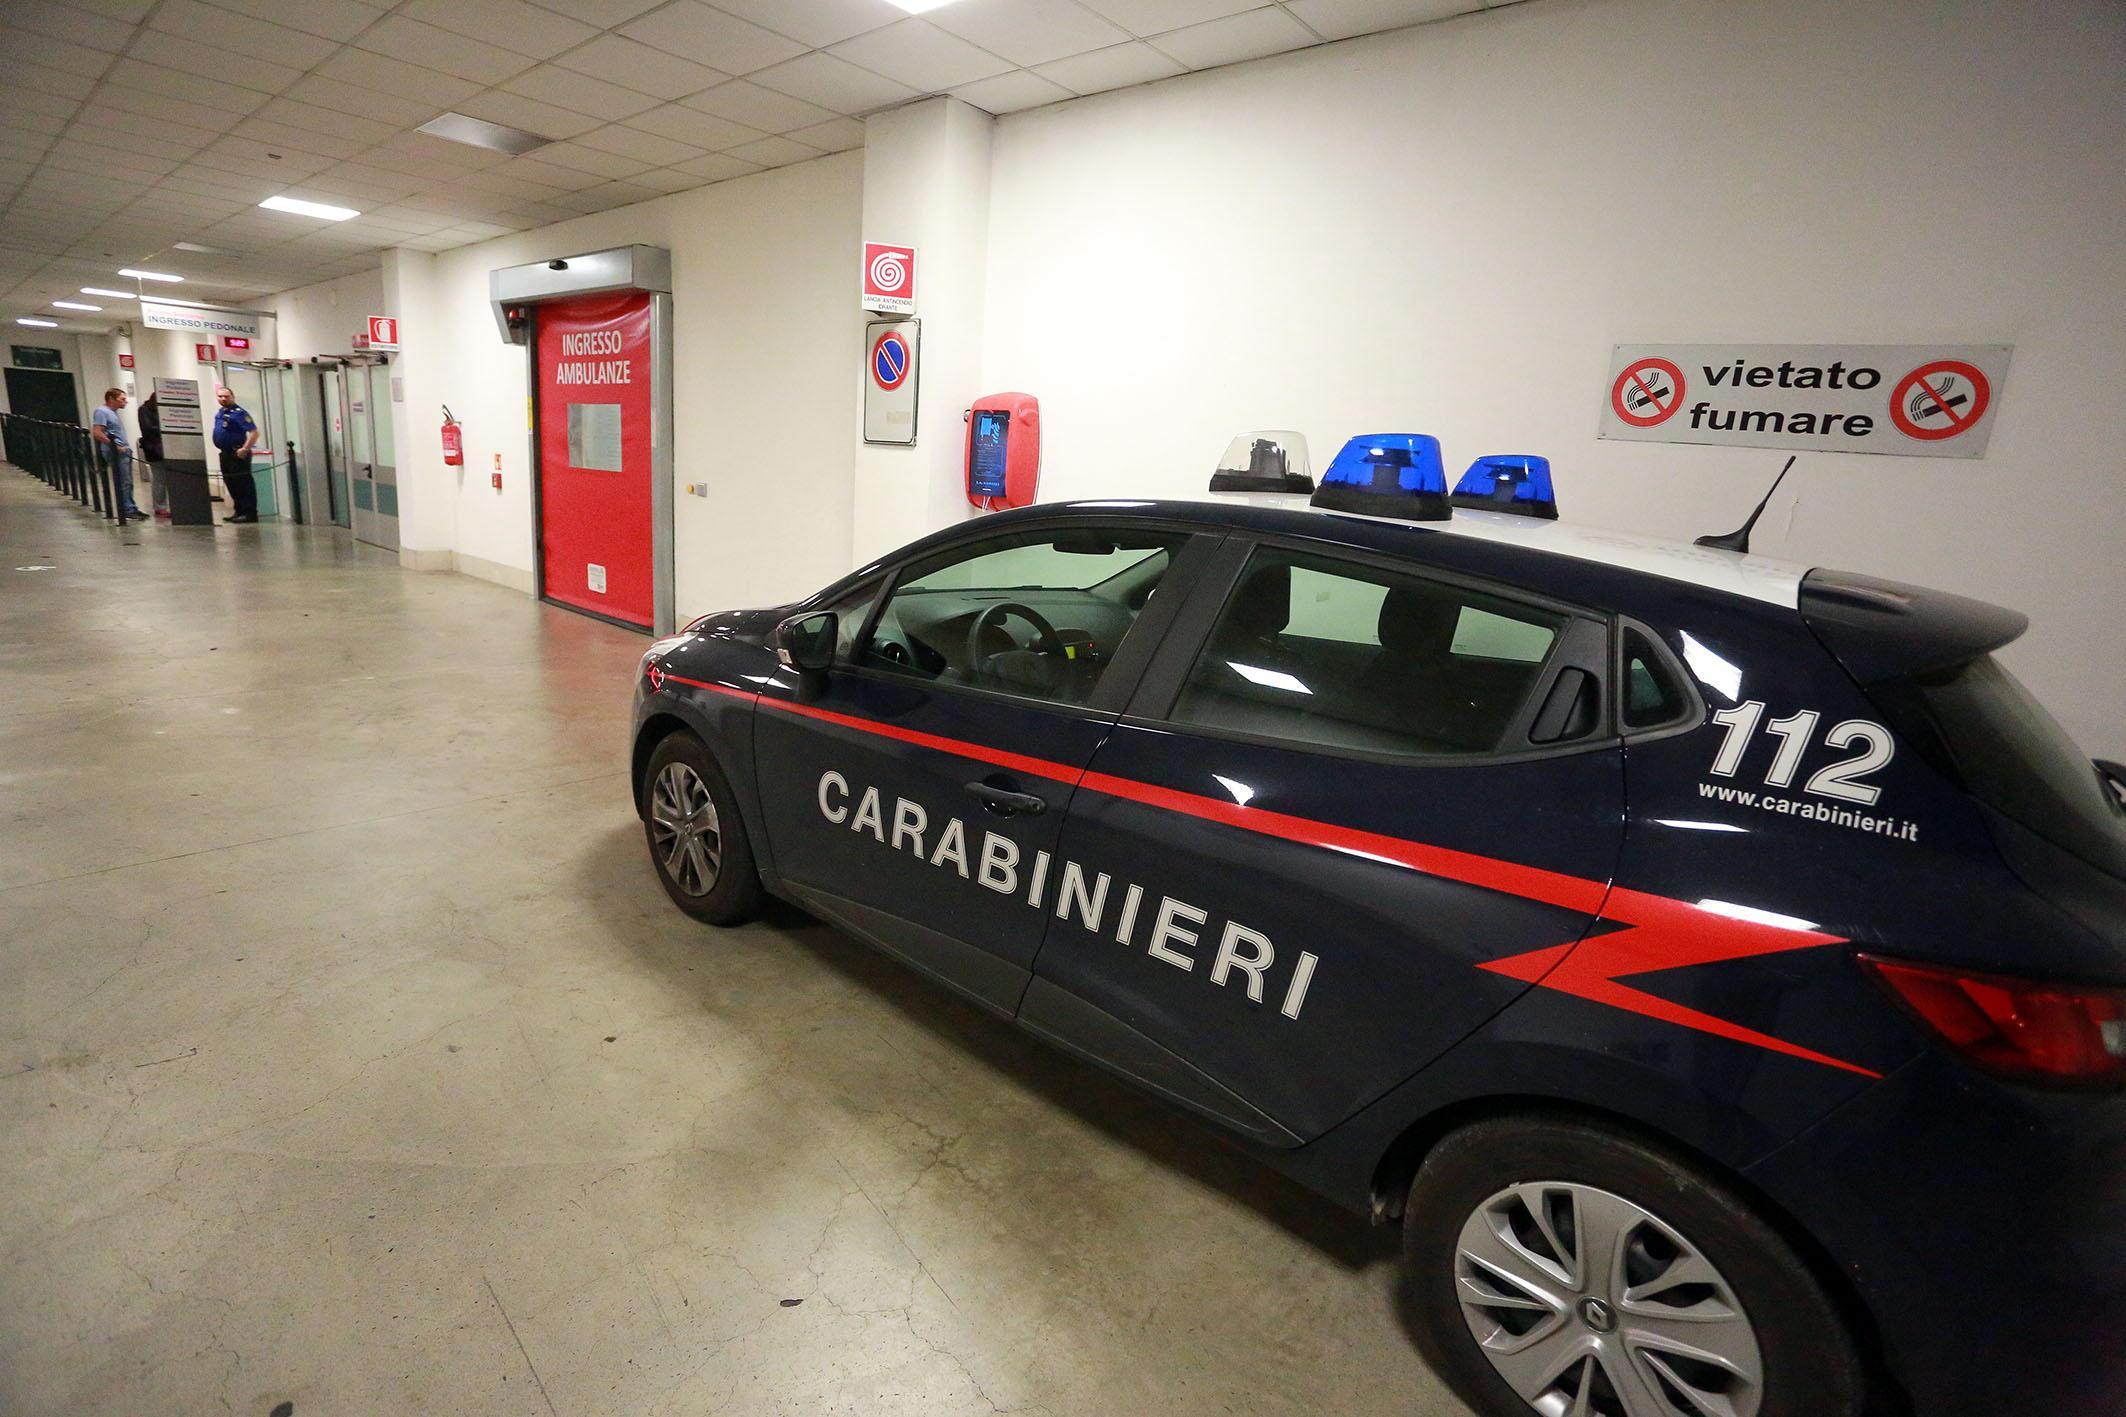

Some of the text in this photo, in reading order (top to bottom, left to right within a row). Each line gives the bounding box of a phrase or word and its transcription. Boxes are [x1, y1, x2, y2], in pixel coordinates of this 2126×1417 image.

[148, 315, 256, 334] INGRESSO PEDONALE
[562, 330, 622, 356] INGRESSO
[556, 360, 631, 385] AMBULANZE
[1702, 359, 1882, 390] vietato
[1690, 402, 1875, 437] fumare
[1709, 700, 1896, 807] 112
[1698, 782, 1919, 842] www.carabinieri.it
[817, 770, 1319, 1021] CARABINIERI
